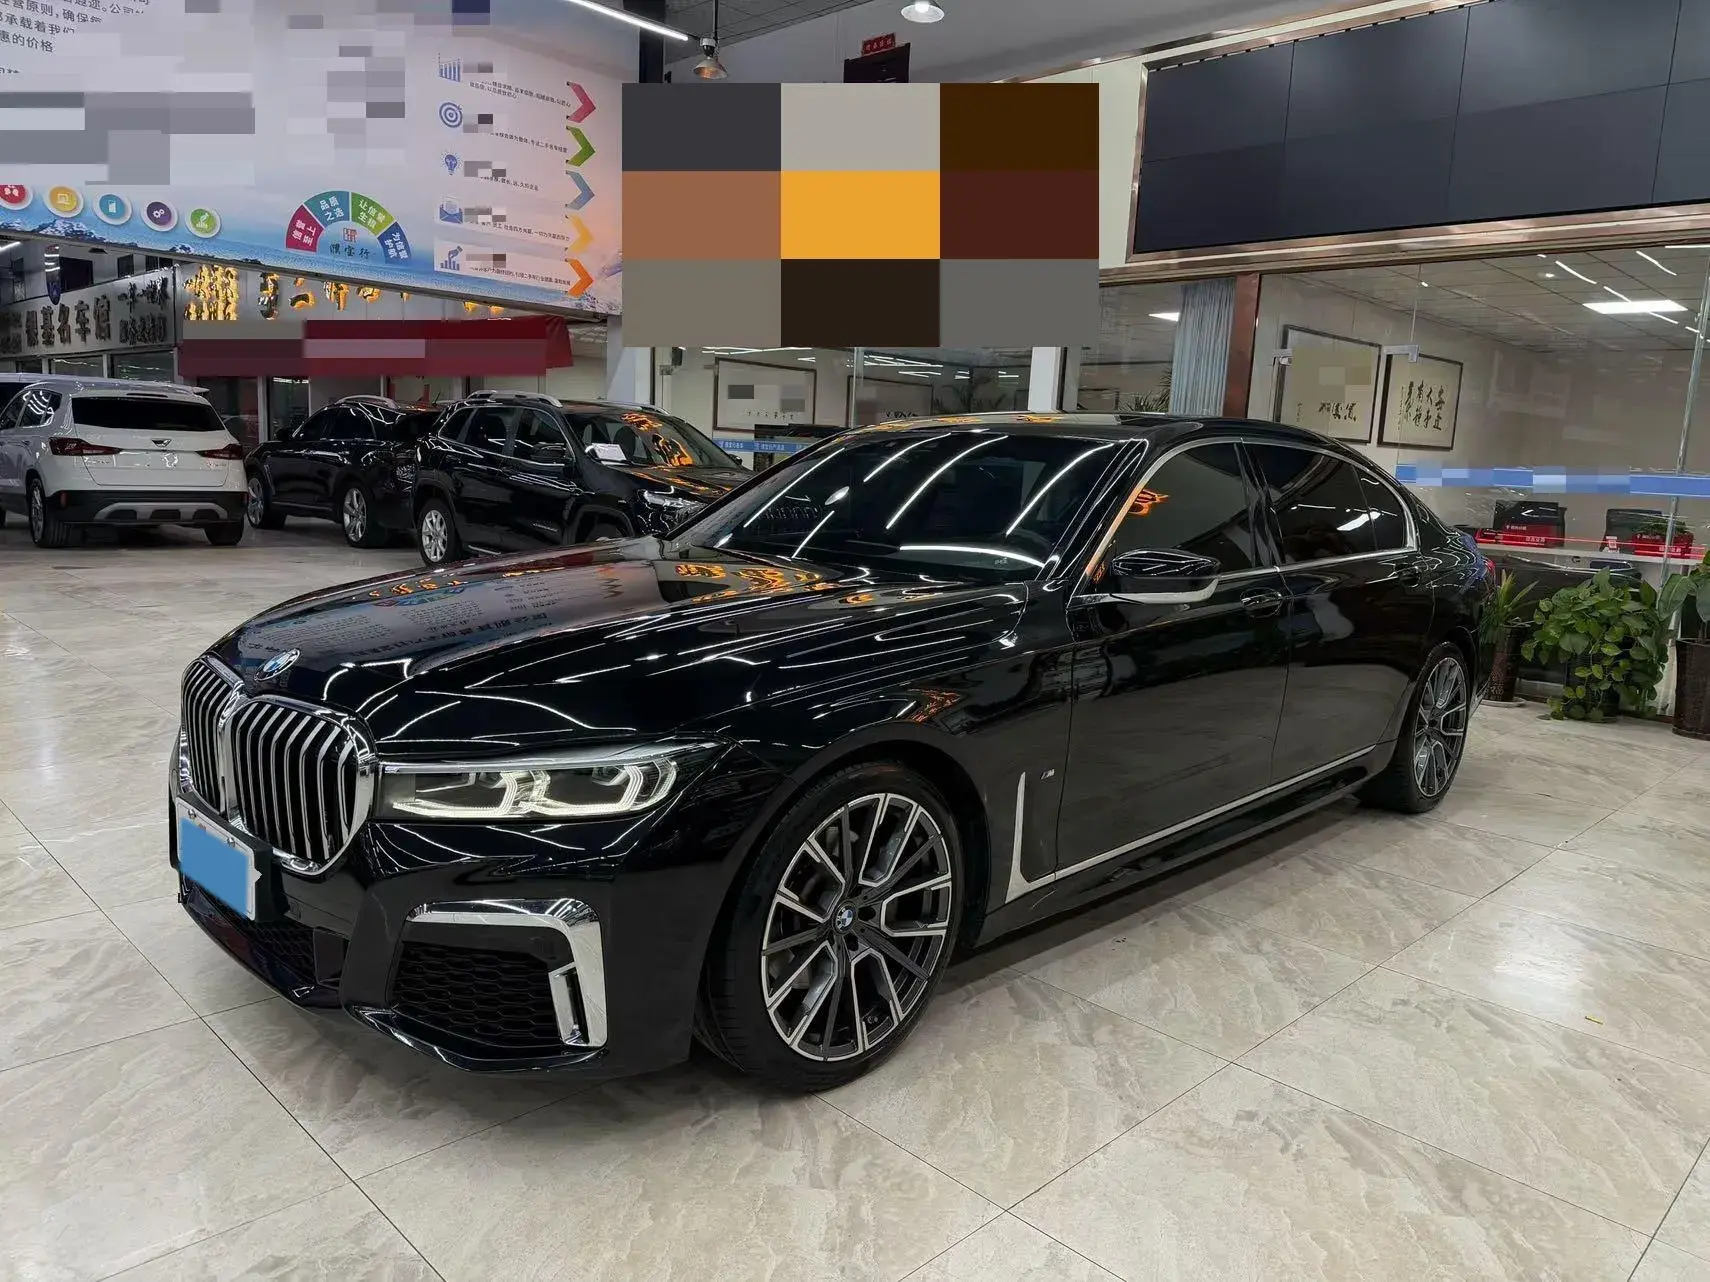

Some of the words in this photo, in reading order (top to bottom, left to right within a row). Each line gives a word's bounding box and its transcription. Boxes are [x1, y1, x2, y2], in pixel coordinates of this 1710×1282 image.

[0, 11, 75, 35] 承载着我们
[320, 196, 340, 210] 品质
[303, 225, 317, 246] 至上
